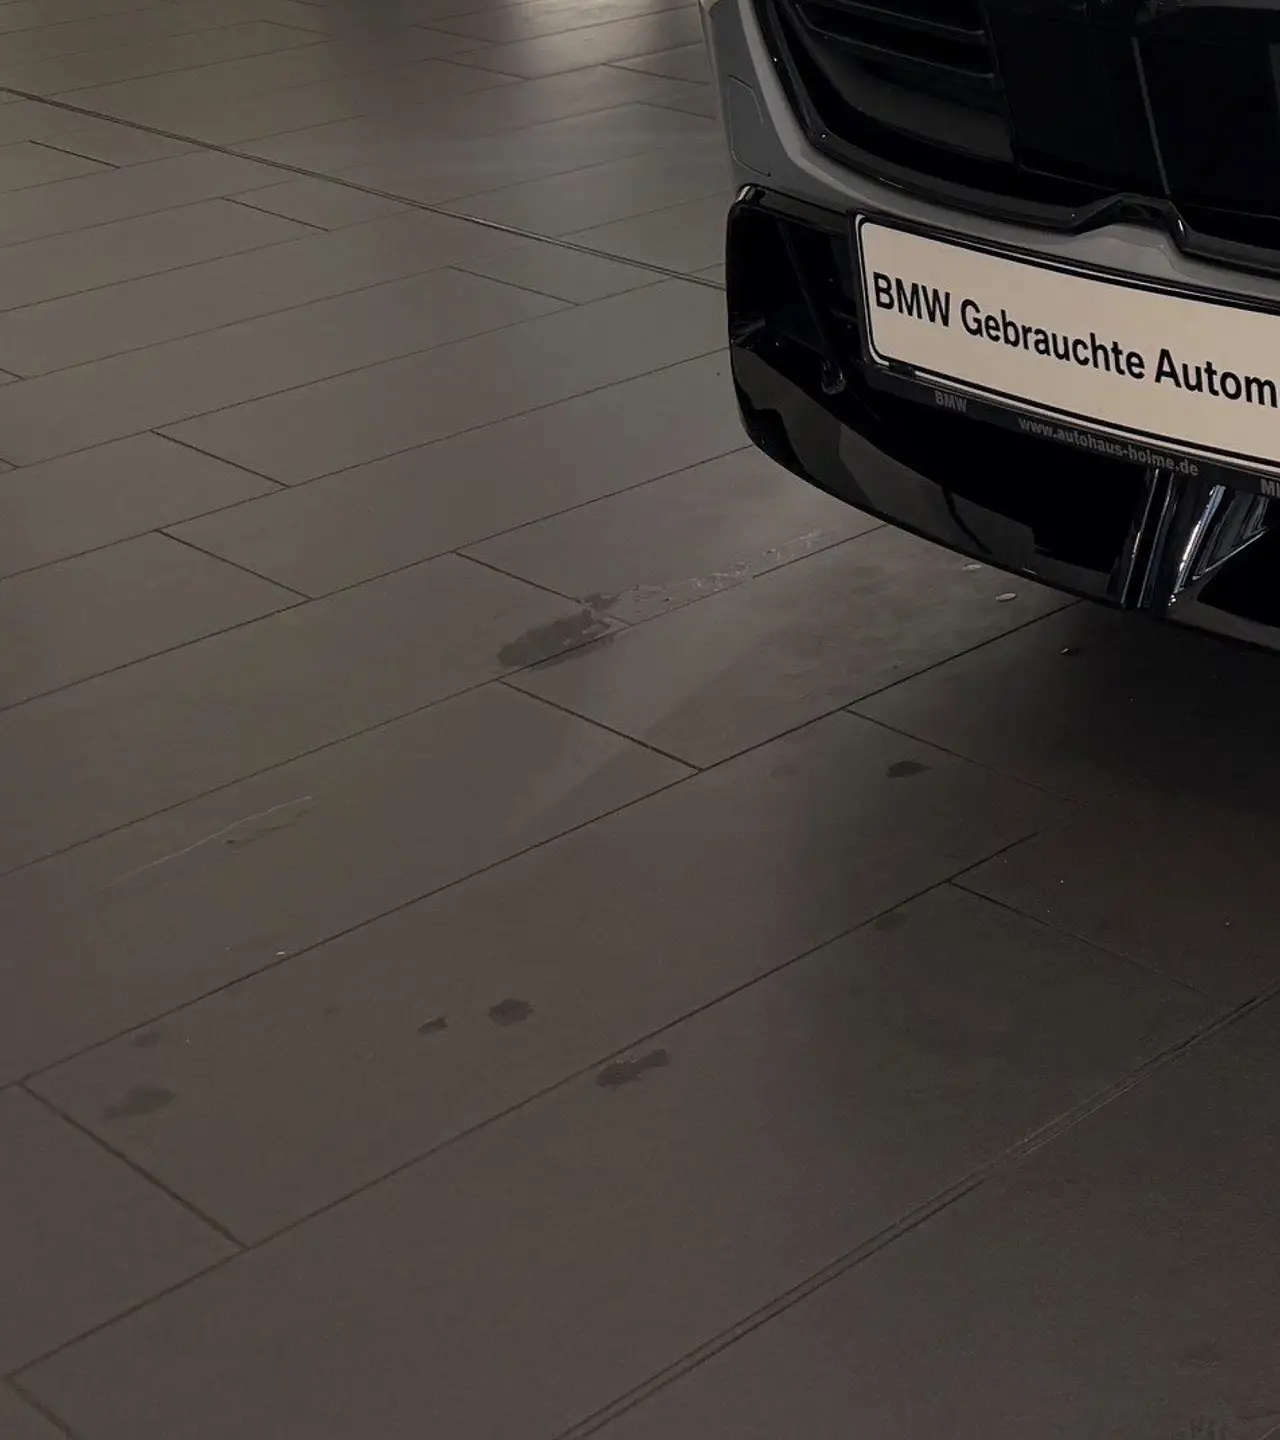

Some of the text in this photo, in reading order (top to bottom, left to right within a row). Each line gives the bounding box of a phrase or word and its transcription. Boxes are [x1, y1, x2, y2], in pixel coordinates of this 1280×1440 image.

[873, 271, 951, 328] BMW
[960, 298, 1145, 380] Gebrauchte
[934, 390, 967, 413] BMW
